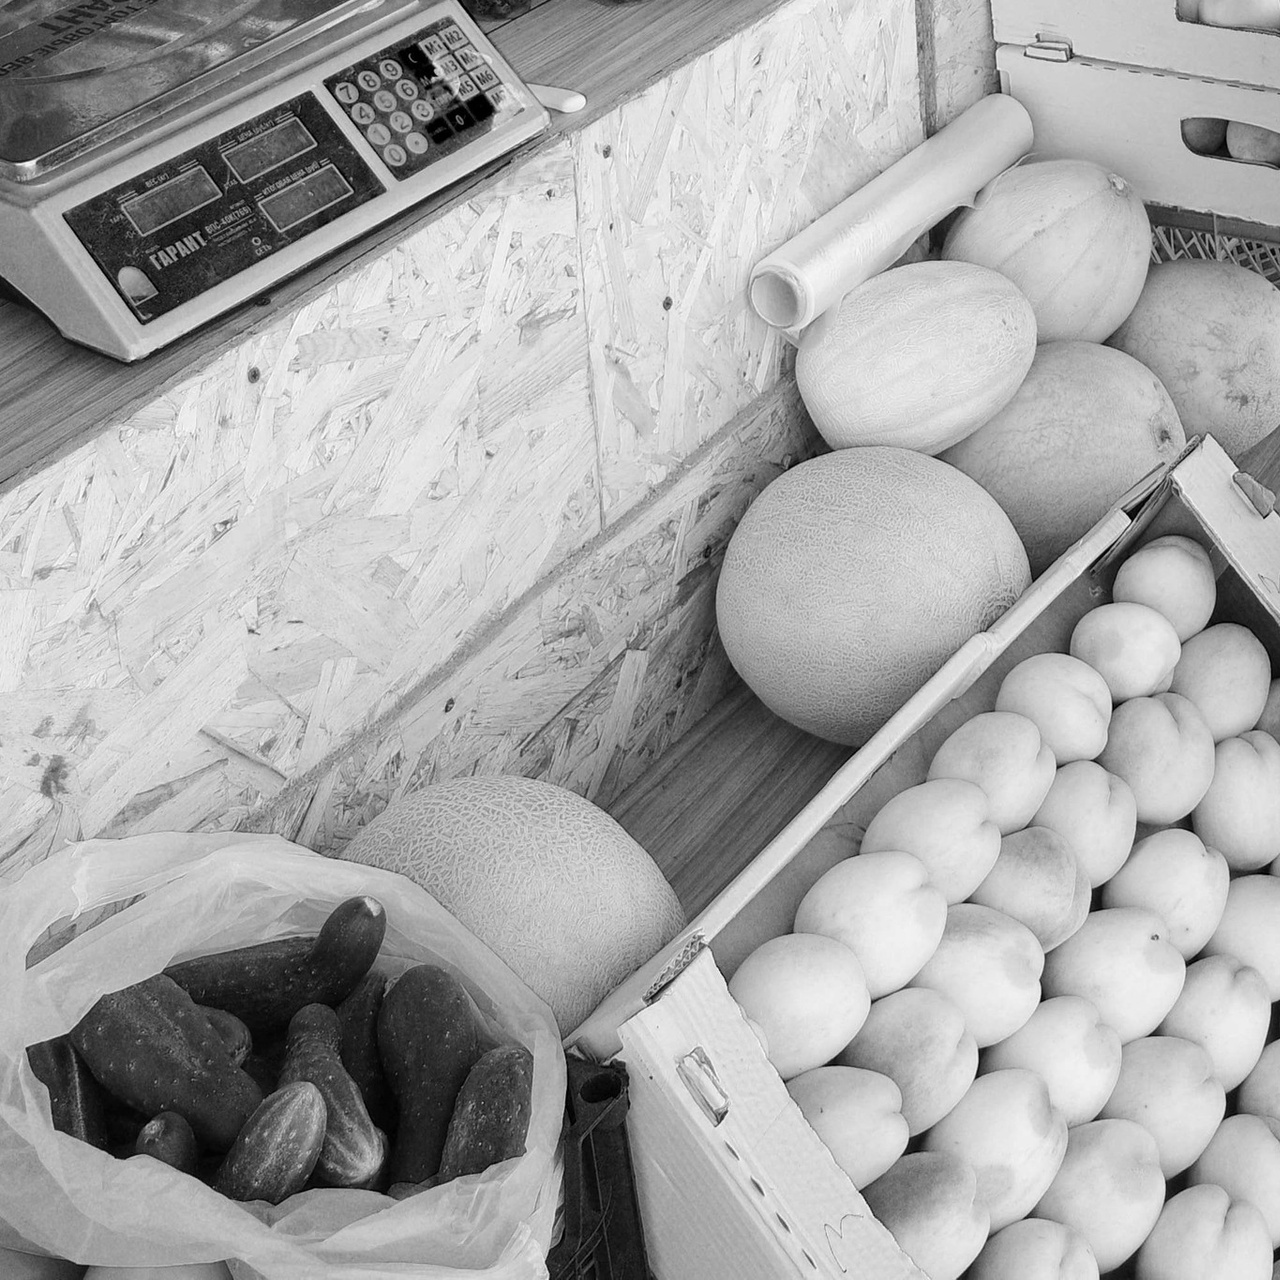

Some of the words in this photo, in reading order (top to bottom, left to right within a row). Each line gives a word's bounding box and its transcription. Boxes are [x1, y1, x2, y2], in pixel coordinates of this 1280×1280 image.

[339, 85, 353, 100] 7
[363, 74, 376, 88] 8
[386, 62, 399, 77] 9
[356, 105, 370, 120] 4
[401, 83, 414, 98] 6
[395, 116, 410, 131] 2
[416, 103, 429, 118] 3
[149, 231, 207, 270] ГАРАНТ
